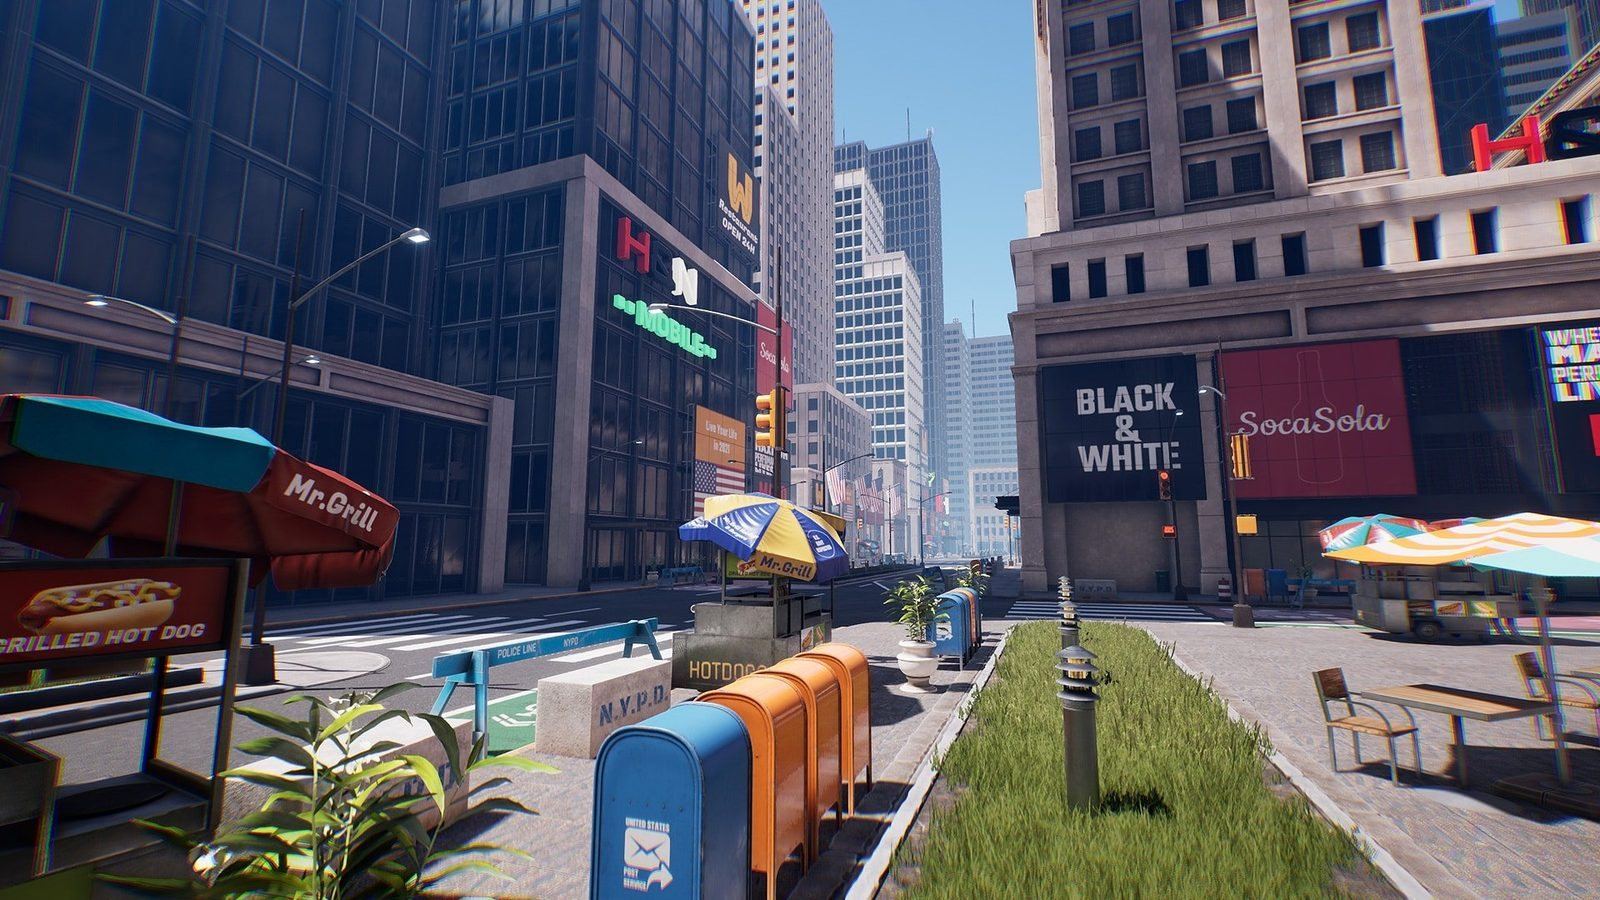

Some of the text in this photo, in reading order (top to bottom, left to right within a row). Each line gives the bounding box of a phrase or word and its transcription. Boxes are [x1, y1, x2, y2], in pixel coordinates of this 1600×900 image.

[728, 152, 753, 225] W
[719, 198, 758, 244] Restaurant
[722, 217, 756, 255] OPEN 24H
[635, 300, 705, 358] MOBILE
[1076, 382, 1177, 416] BLACK
[1115, 414, 1142, 443] &
[1237, 404, 1391, 438] SocaSola
[1077, 441, 1182, 472] WHITE
[283, 473, 379, 533] Mr.Grill
[760, 555, 812, 578] Mr.Grill
[104, 626, 157, 645] HOT
[162, 622, 206, 641] DOG
[497, 636, 579, 659] POLICE LINE NYPD
[599, 684, 669, 727] N.Y.P.D.
[625, 816, 670, 833] UNITED STATES
[623, 865, 639, 879] POST
